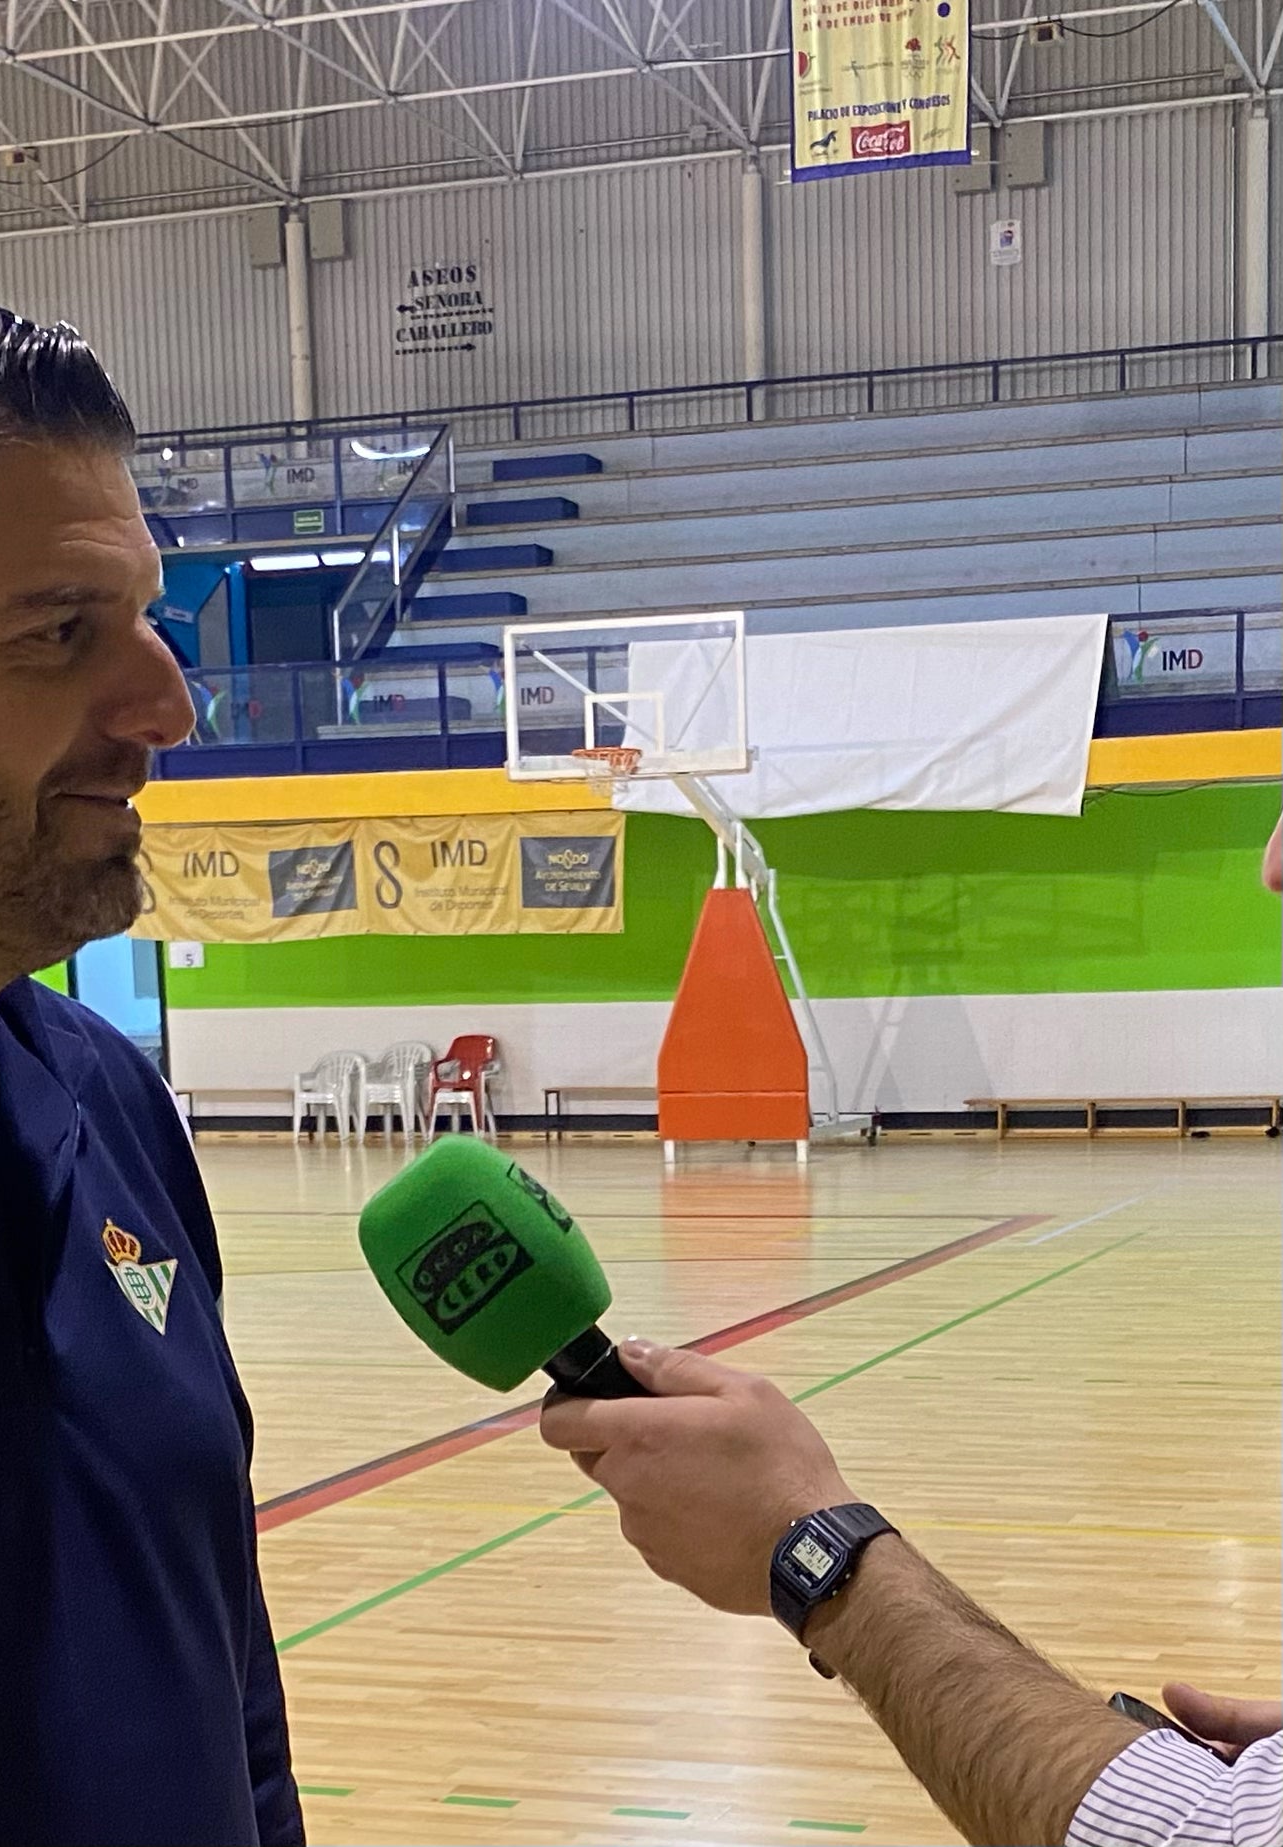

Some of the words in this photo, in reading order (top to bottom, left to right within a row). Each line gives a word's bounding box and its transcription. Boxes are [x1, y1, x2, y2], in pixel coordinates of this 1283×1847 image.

[840, 106, 851, 118] DE
[408, 265, 477, 288] ASEOS
[396, 321, 493, 342] CABALLERO
[287, 468, 315, 484] IMD
[1162, 649, 1204, 671] IMD
[520, 686, 555, 705] IMD
[183, 851, 240, 878] IMD
[430, 840, 488, 868] IMD
